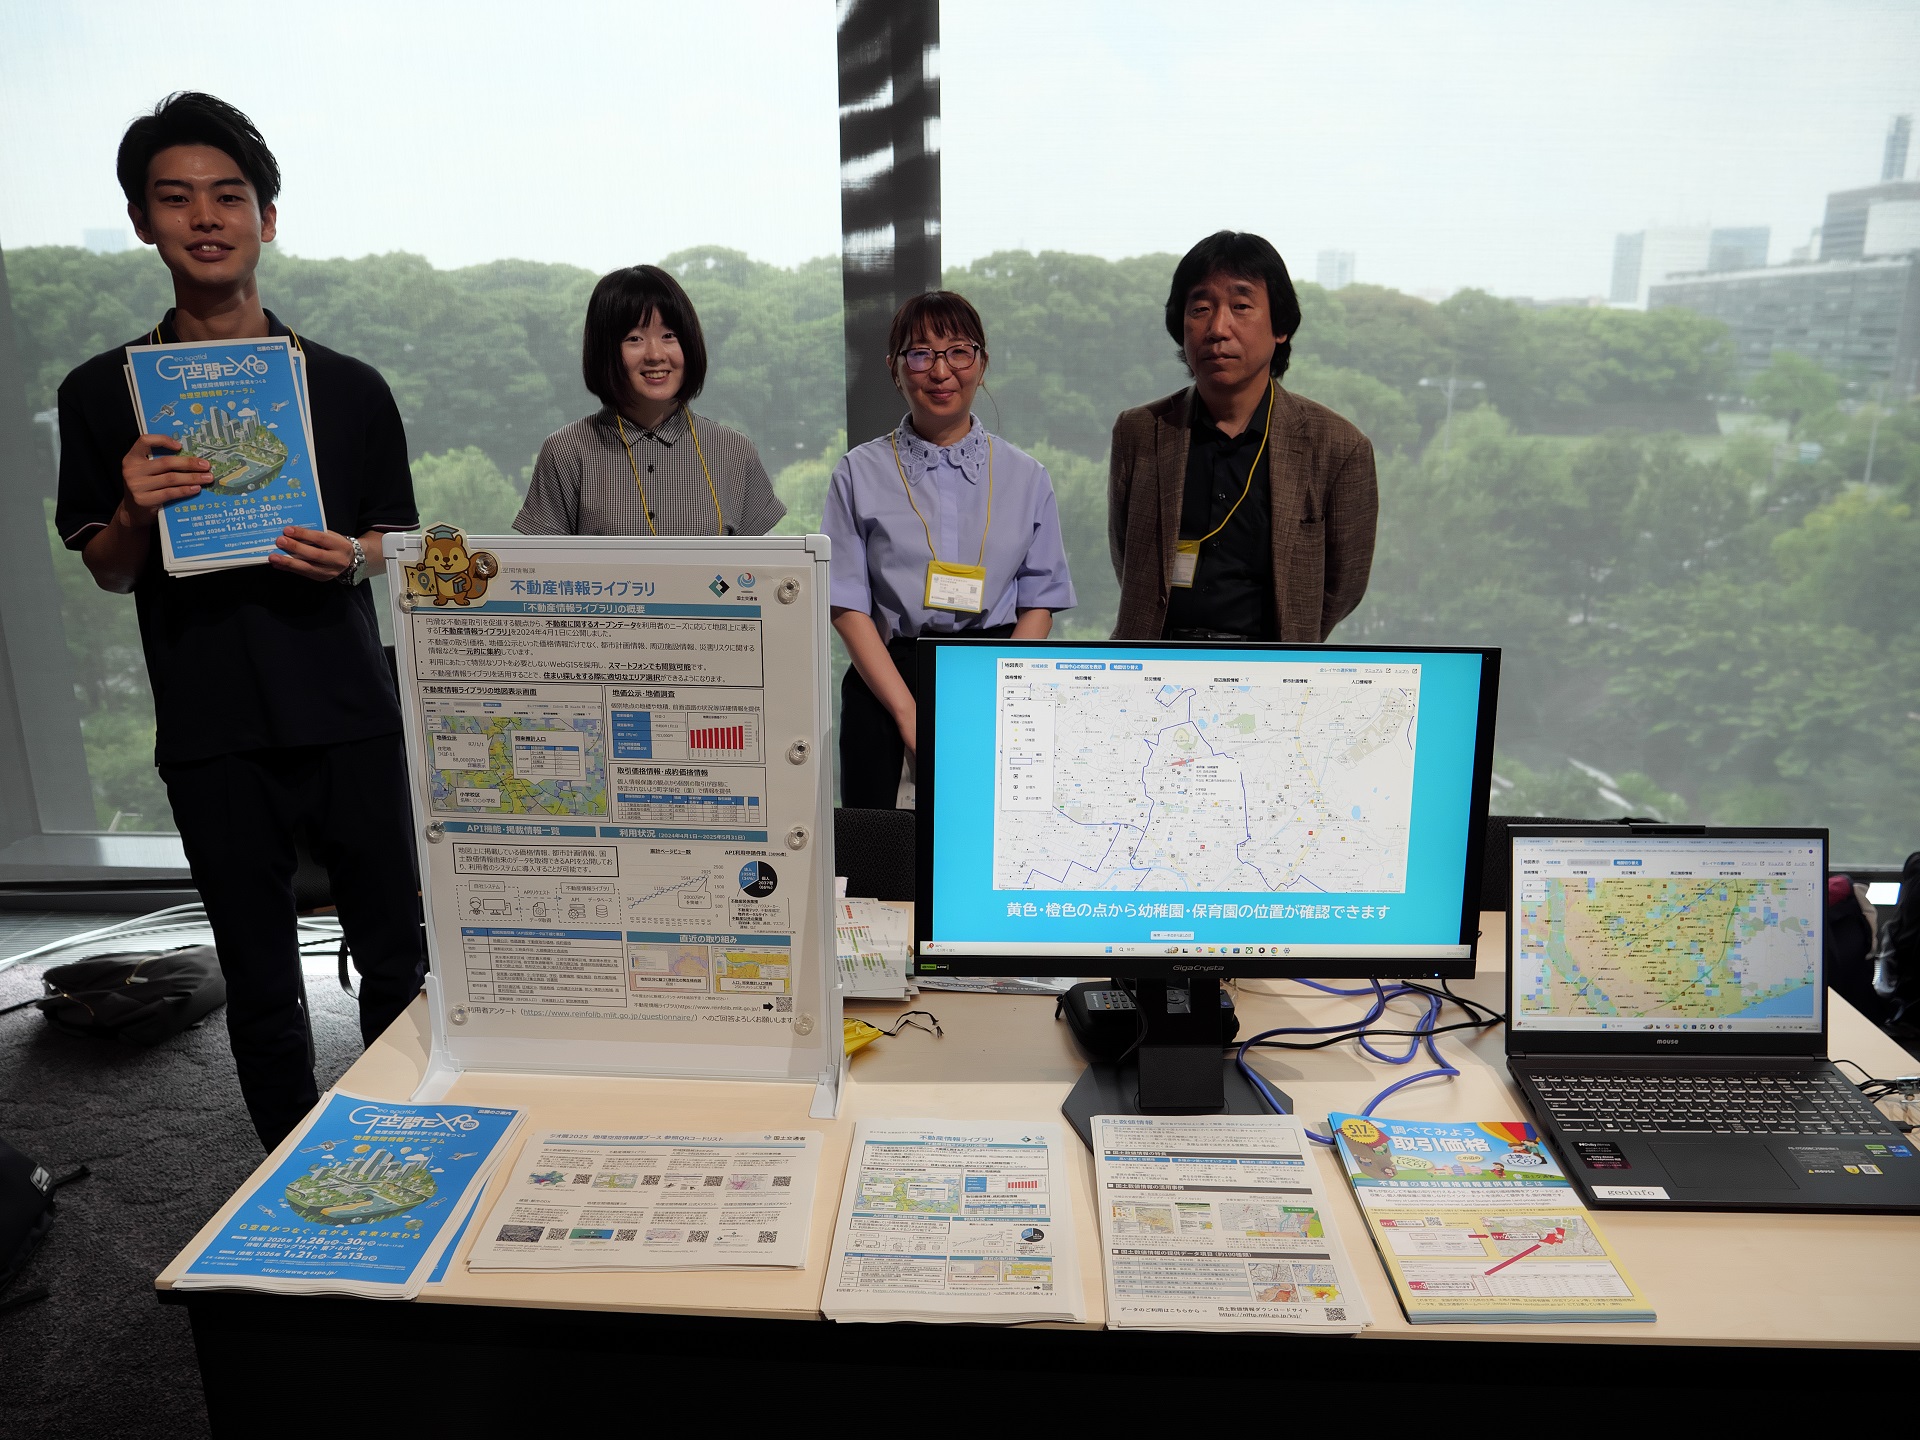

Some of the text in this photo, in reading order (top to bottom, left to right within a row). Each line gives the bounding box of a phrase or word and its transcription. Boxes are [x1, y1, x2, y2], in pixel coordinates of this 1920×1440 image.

[179, 388, 256, 400] 地理空間情報フォーラム
[510, 580, 655, 597] 不動産情報ライブラリ
[523, 602, 645, 614] 「不動産情報ライブラリ」の概要
[427, 627, 612, 638] する「不動産情報ライブラリ」を2024年4月1日に公開しました。
[428, 647, 534, 656] 情報などを一元的に集約しています。
[423, 686, 537, 696] 不動産情報ライブラリの地図表示画面
[612, 689, 676, 699] 地価公示・地価調査
[617, 767, 709, 777] 取引価格情報・成約価格情報
[466, 824, 561, 836] API機能・掲載情報一覧
[619, 828, 656, 838] 利用状況
[458, 847, 607, 858] 地図上に掲載している価格情報、都市計画情報、国
[459, 856, 613, 866] 土数値情報由来のデータを取得できるAPIを公開してお
[459, 864, 592, 873] り、利用者のシステムに導入することが可能です。
[1006, 902, 1390, 921] 黄色・橙色の点から幼稚園・保育園の位置が確認できます
[679, 934, 738, 944] 直近の取り組み
[467, 1007, 517, 1015] 利用者アンケート
[1349, 1124, 1368, 1135] 517
[1391, 1126, 1476, 1137] 調べてみよう
[352, 1135, 445, 1144] 地理空間情報フォーラム
[919, 1135, 994, 1143] 不動産情報ライブラリ
[1392, 1136, 1492, 1153] 取引価格
[1378, 1180, 1544, 1188] 不動産の取引価格情報提供制度とは
[1608, 1188, 1655, 1197] geoinfo
[262, 1242, 318, 1251] 東京ビッグサイト
